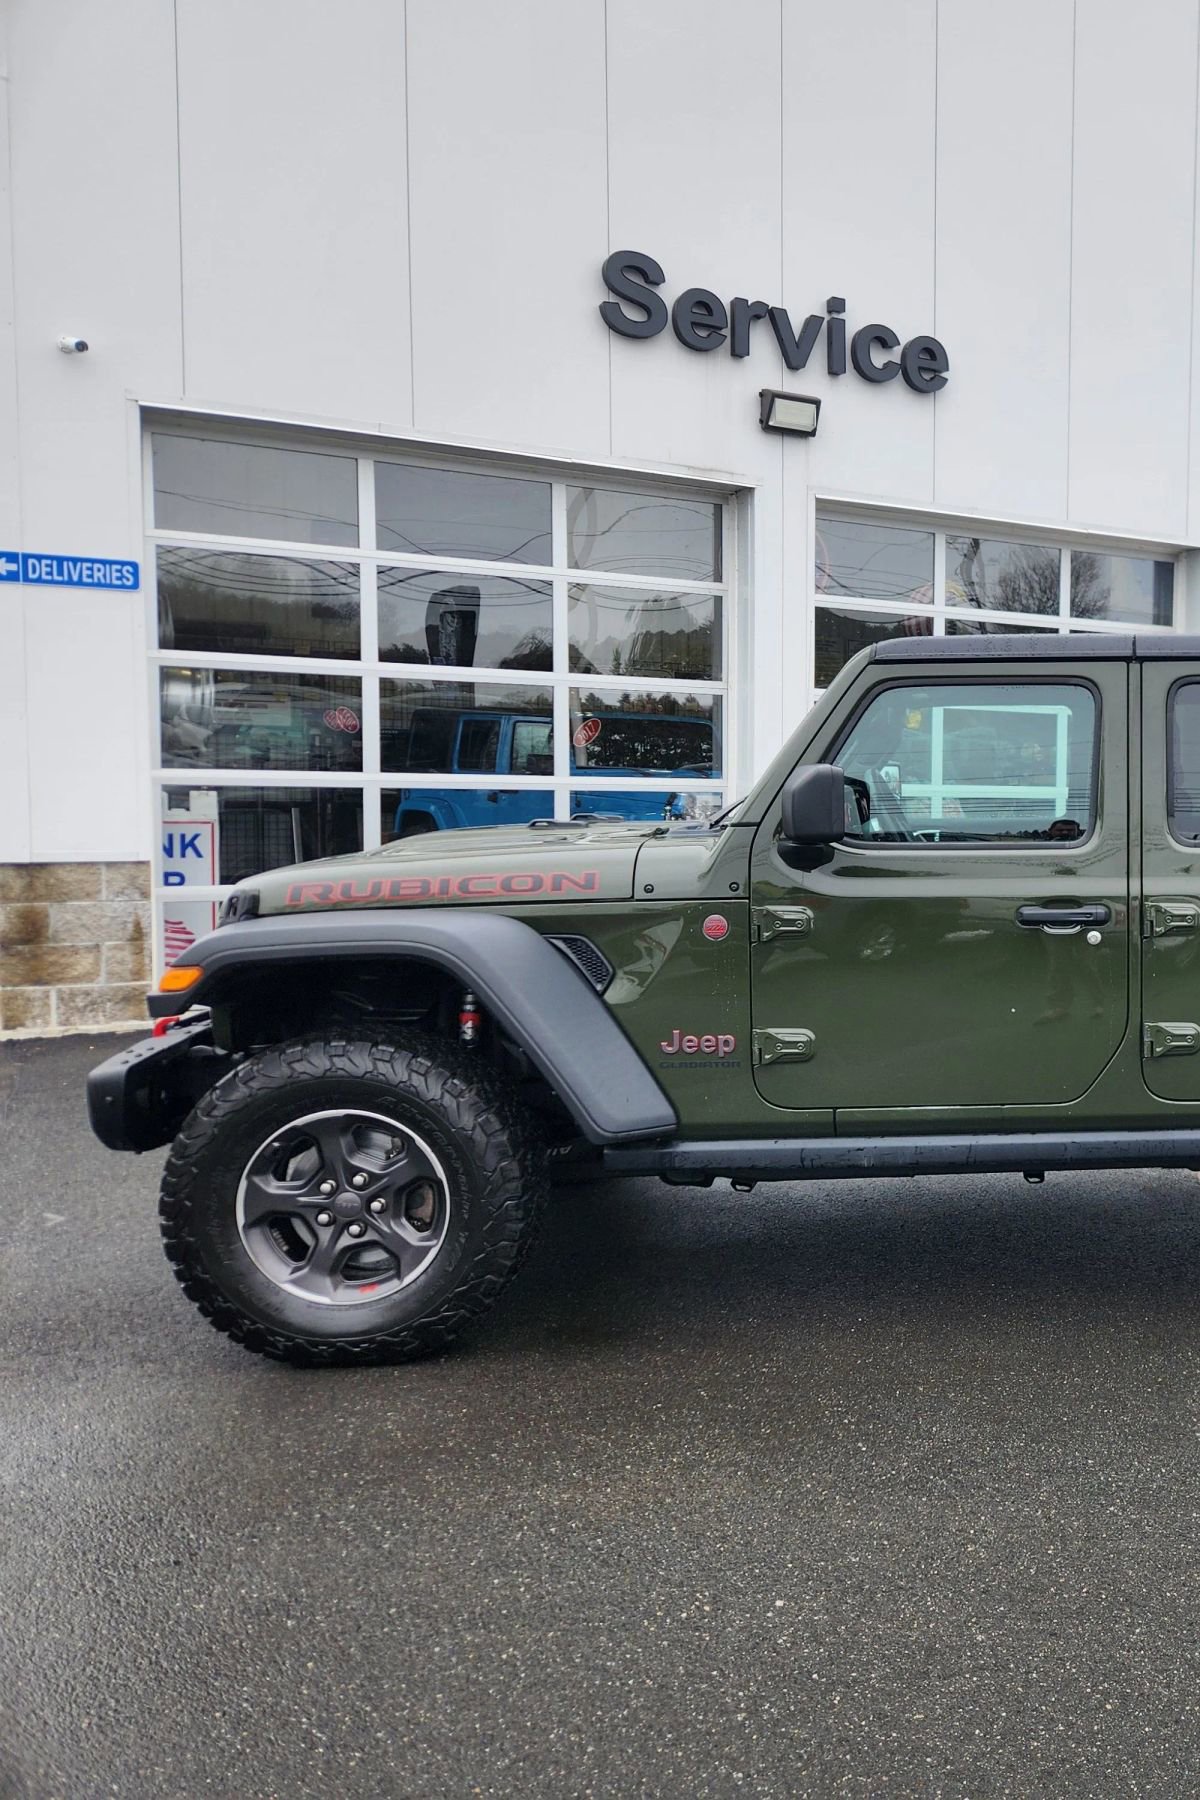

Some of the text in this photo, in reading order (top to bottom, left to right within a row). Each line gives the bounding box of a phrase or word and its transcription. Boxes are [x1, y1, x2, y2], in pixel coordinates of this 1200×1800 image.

[599, 249, 950, 394] Service
[27, 558, 135, 586] DELIVERIES
[286, 869, 600, 908] RUBICON
[661, 1029, 736, 1058] Jeep
